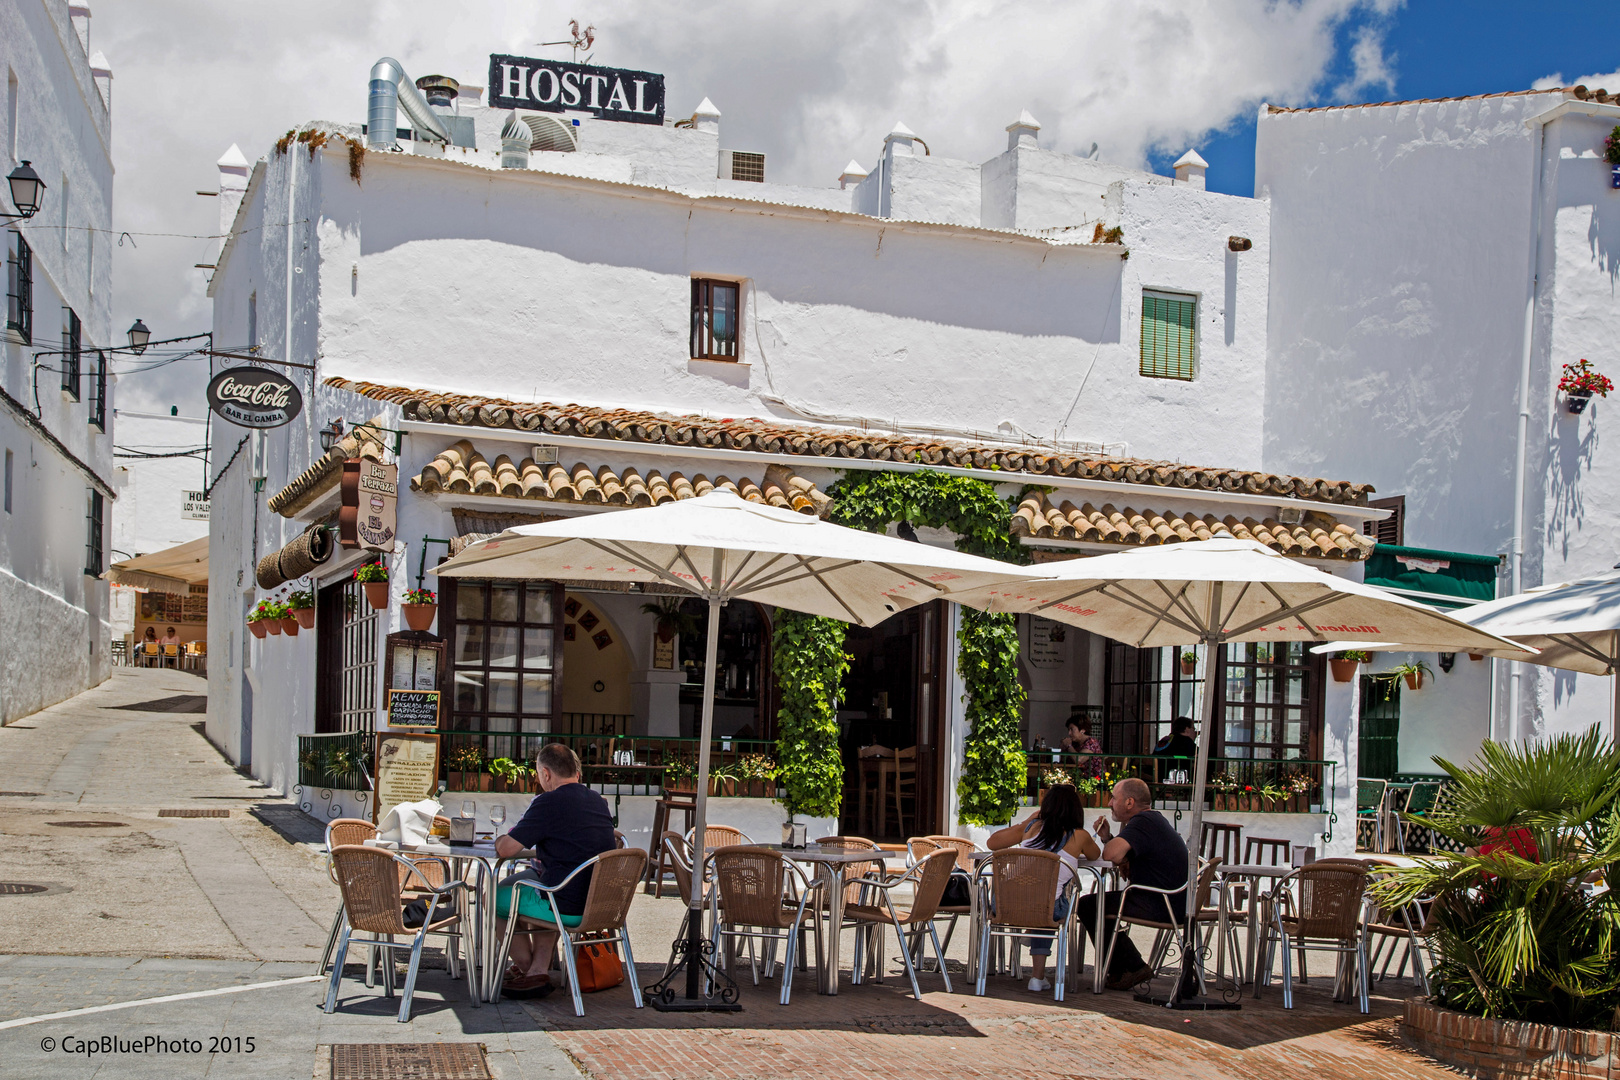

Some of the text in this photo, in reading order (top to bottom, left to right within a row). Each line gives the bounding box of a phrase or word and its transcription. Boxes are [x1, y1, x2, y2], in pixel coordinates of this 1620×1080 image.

[499, 63, 659, 115] HOSTAL
[216, 376, 292, 408] Coca-Cola
[225, 406, 283, 423] BAR EL GAMBA
[371, 465, 387, 479] Bar
[361, 475, 395, 493] Terraza
[184, 503, 194, 511] LOS
[368, 515, 383, 530] EL
[358, 521, 394, 546] GAMBA
[391, 692, 424, 702] MENU
